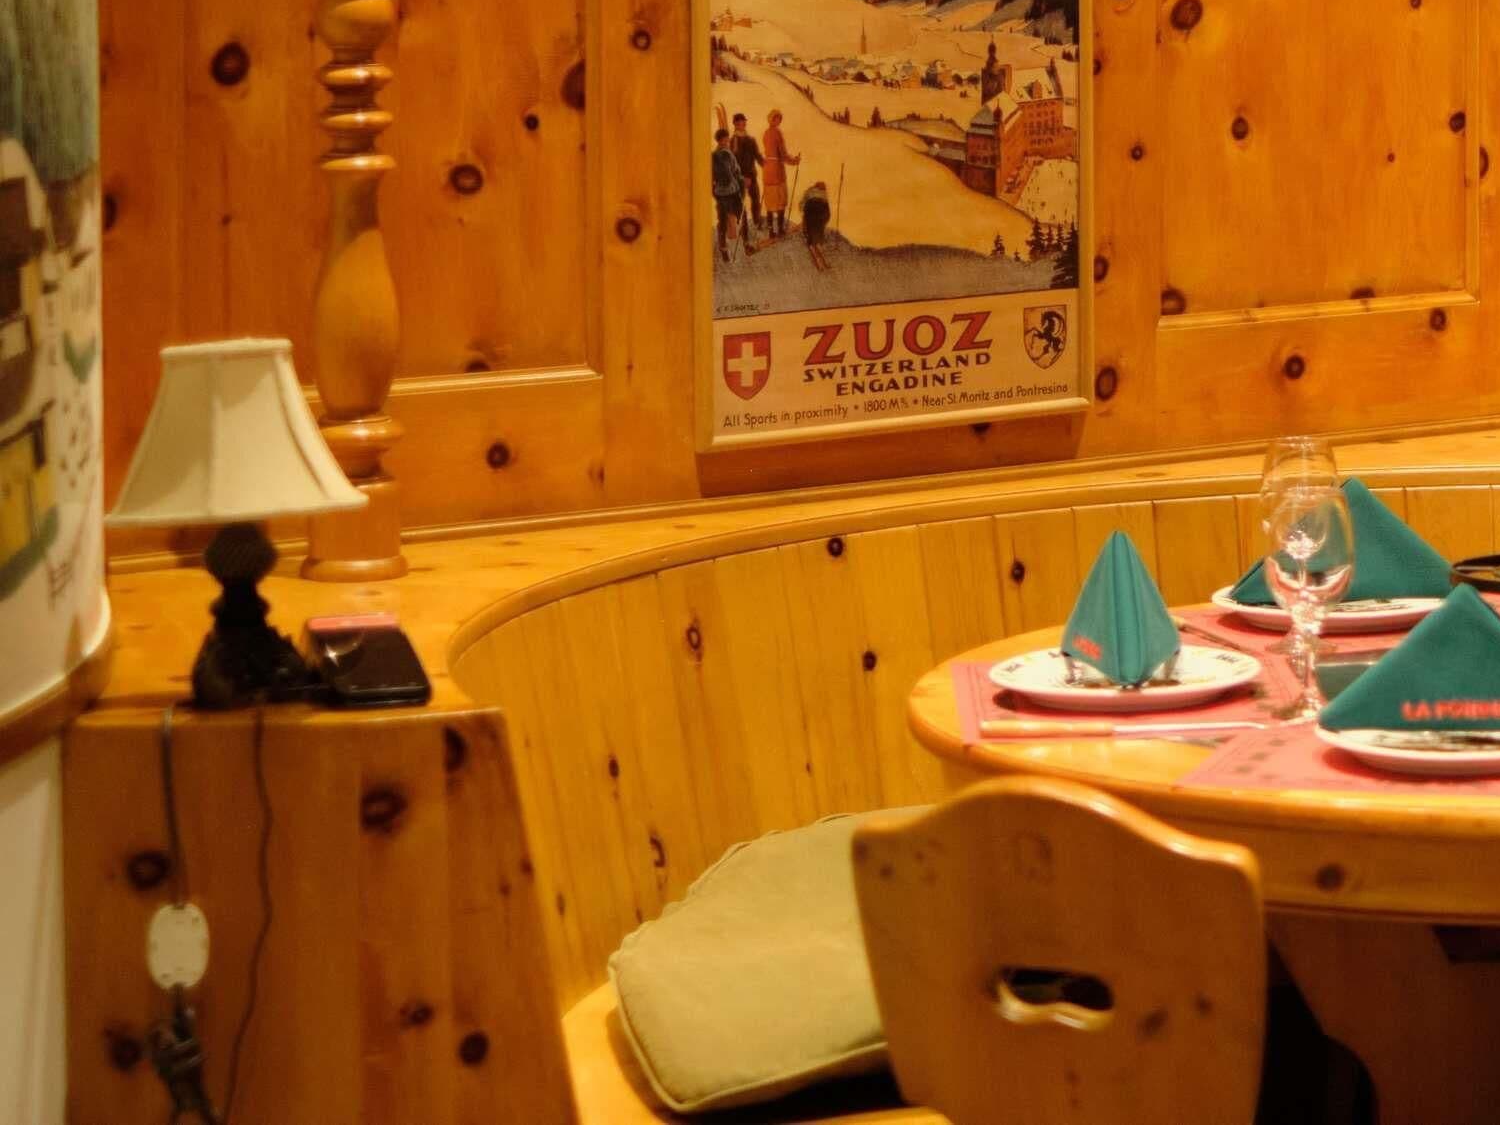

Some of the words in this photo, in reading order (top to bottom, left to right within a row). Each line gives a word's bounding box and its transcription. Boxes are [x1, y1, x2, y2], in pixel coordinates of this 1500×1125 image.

[802, 311, 993, 366] ZUOZ
[803, 352, 991, 382] SWITZERLAND
[836, 372, 962, 396] ENGADINE
[723, 415, 740, 427] All
[744, 412, 778, 429] Sports
[781, 411, 791, 421] in
[794, 404, 848, 424] proximity
[863, 399, 887, 413] 1800
[922, 394, 946, 407] Near
[959, 390, 990, 403] Moritz
[993, 387, 1013, 400] and
[1016, 382, 1068, 397] Pontresina
[1402, 699, 1430, 722] LA
